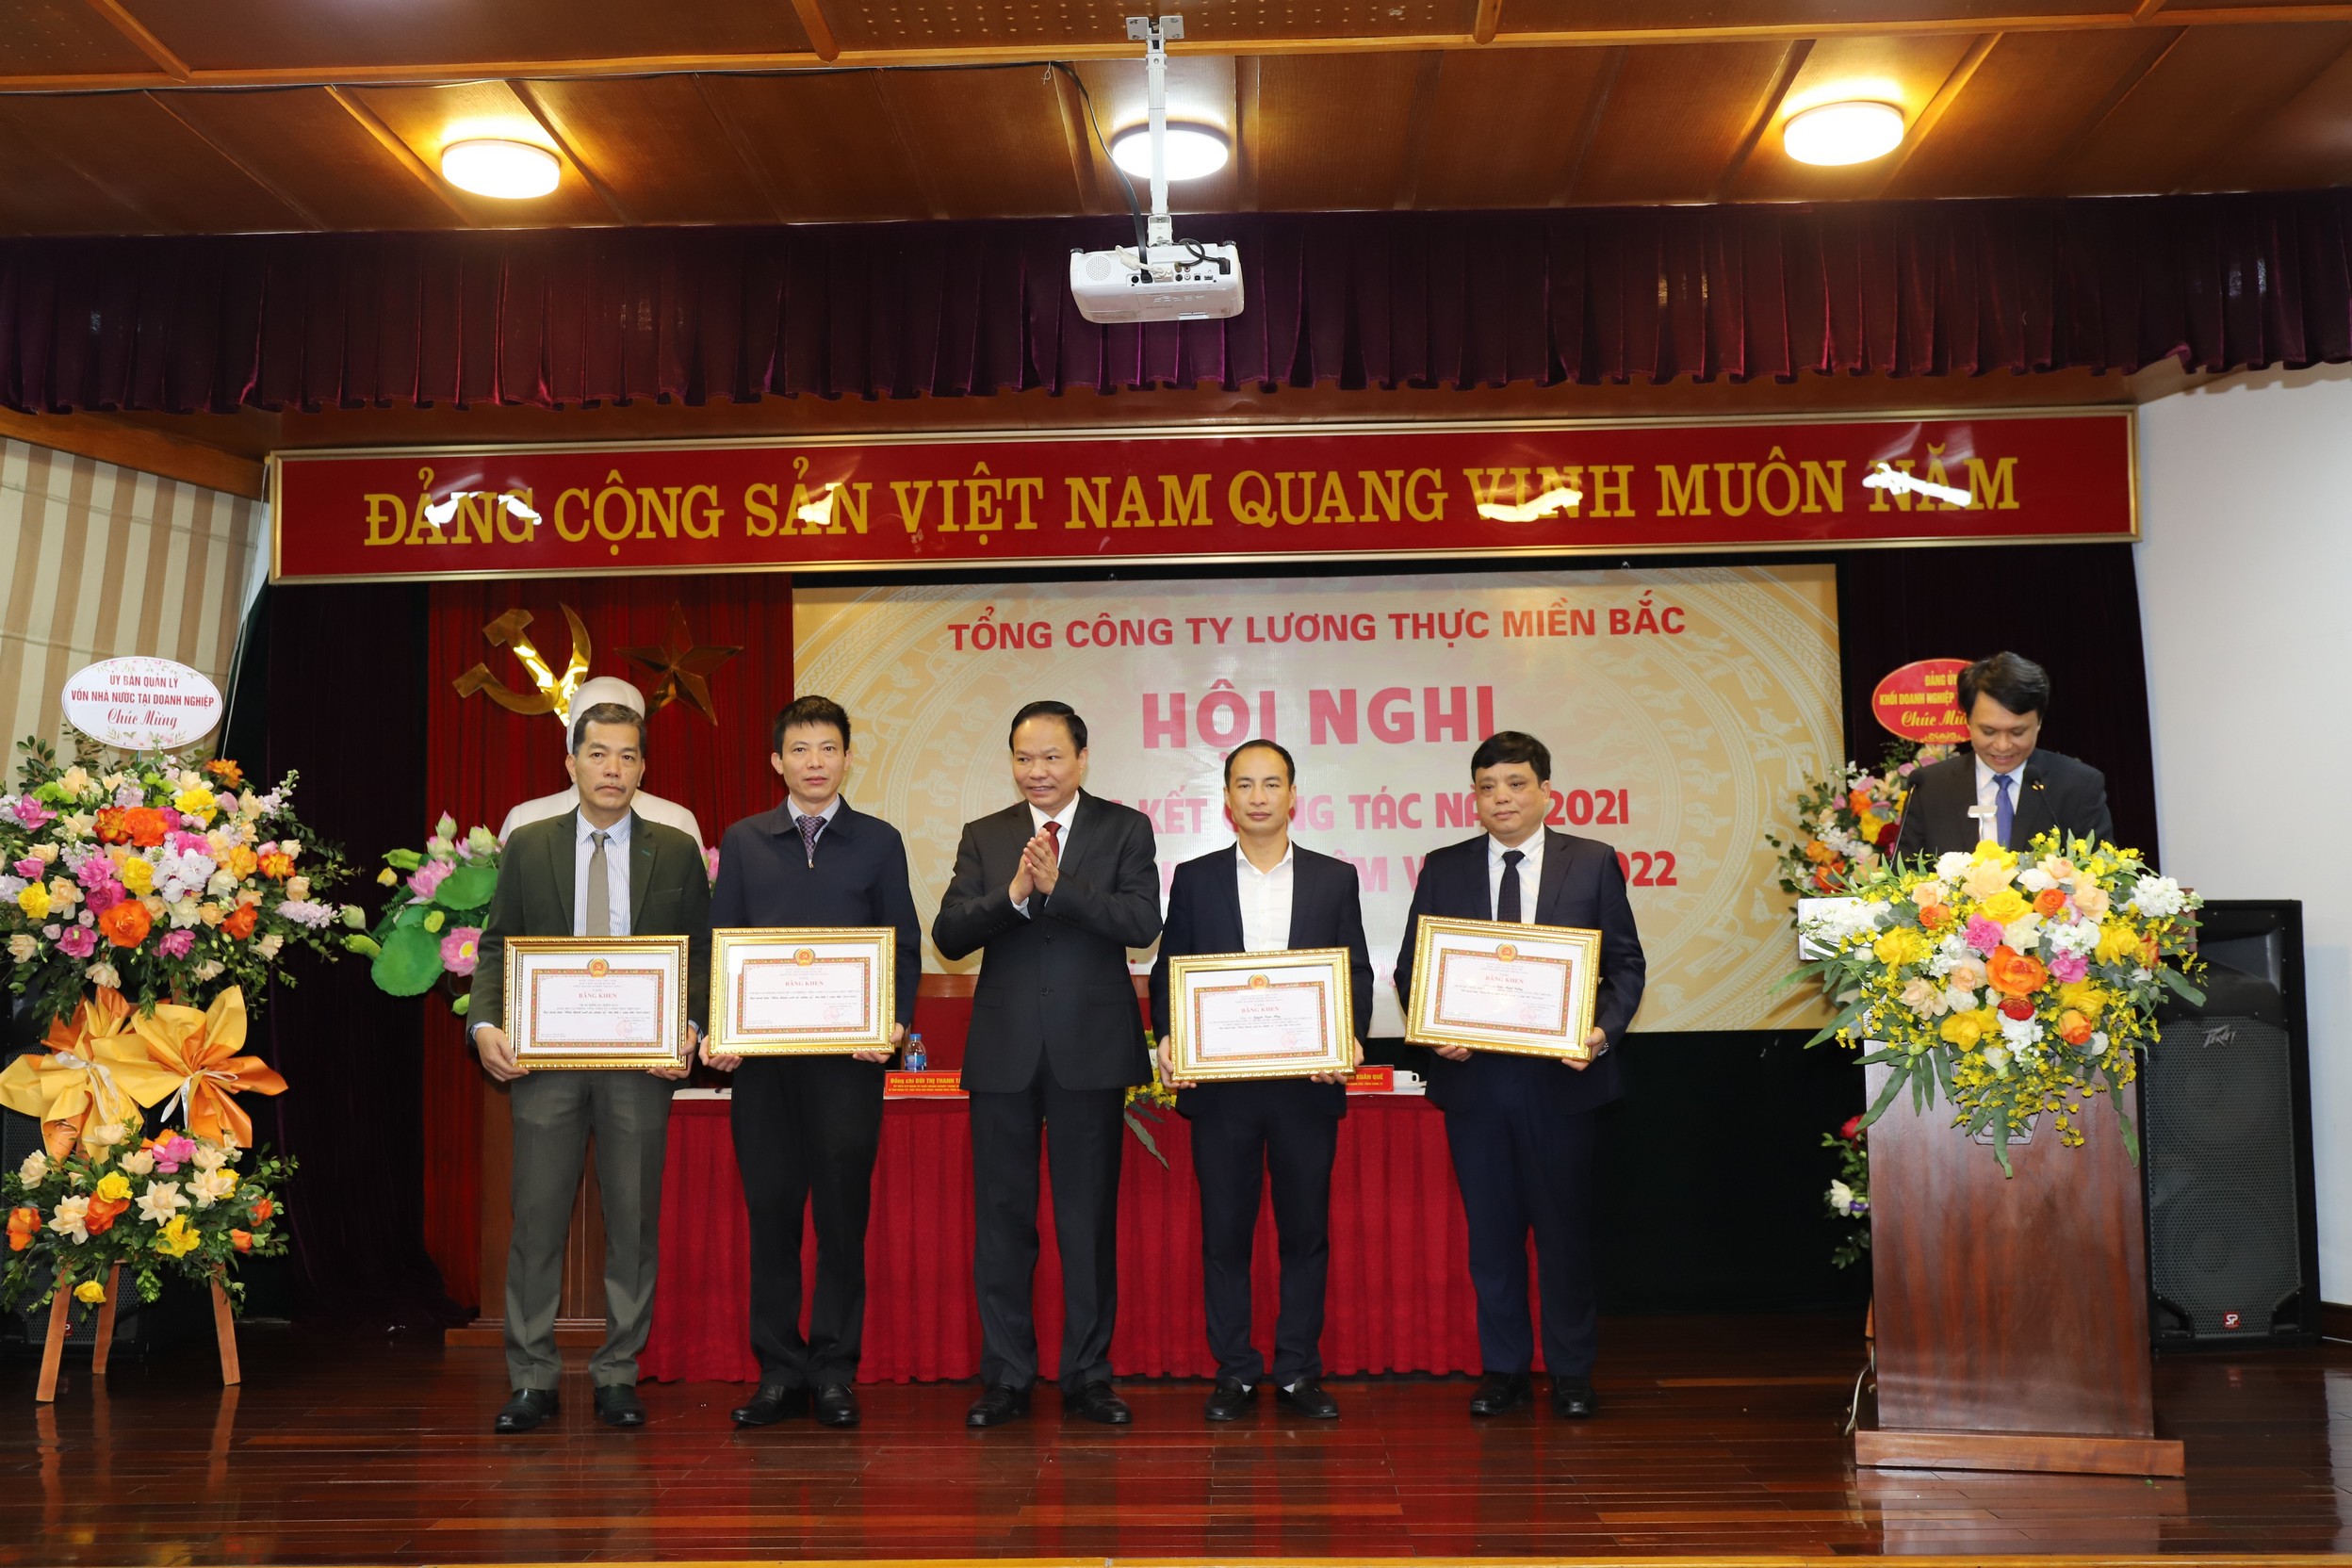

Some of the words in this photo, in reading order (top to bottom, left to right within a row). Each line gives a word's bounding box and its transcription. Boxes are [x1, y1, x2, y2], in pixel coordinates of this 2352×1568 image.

[364, 466, 535, 546] ĐẢNG
[553, 469, 725, 556] CỘNG
[743, 456, 873, 537] SẢN
[890, 461, 1044, 546] VIỆT
[1064, 473, 1214, 530] NAM
[1228, 467, 1448, 528] QUANG
[1462, 465, 1636, 521] VINH
[1655, 445, 1847, 517] MUÔN
[1866, 442, 2019, 512] NĂM
[948, 606, 1053, 651] TỔNG
[1066, 612, 1173, 648] CÔNG
[1184, 616, 1233, 645] TY
[1246, 611, 1376, 644] LƯƠNG
[1387, 608, 1490, 648] THỰC
[1502, 596, 1595, 638] MIỀN
[1609, 589, 1686, 636] BẮC
[153, 694, 182, 706] DOANH
[1899, 693, 1925, 706] DOANH
[107, 708, 139, 726] Chúc
[1142, 678, 1277, 762] HỘI
[1901, 710, 1937, 727] Chúc
[1137, 786, 1208, 835] KẾT
[1348, 785, 1422, 830] TÁC
[1544, 789, 1629, 825] 2021
